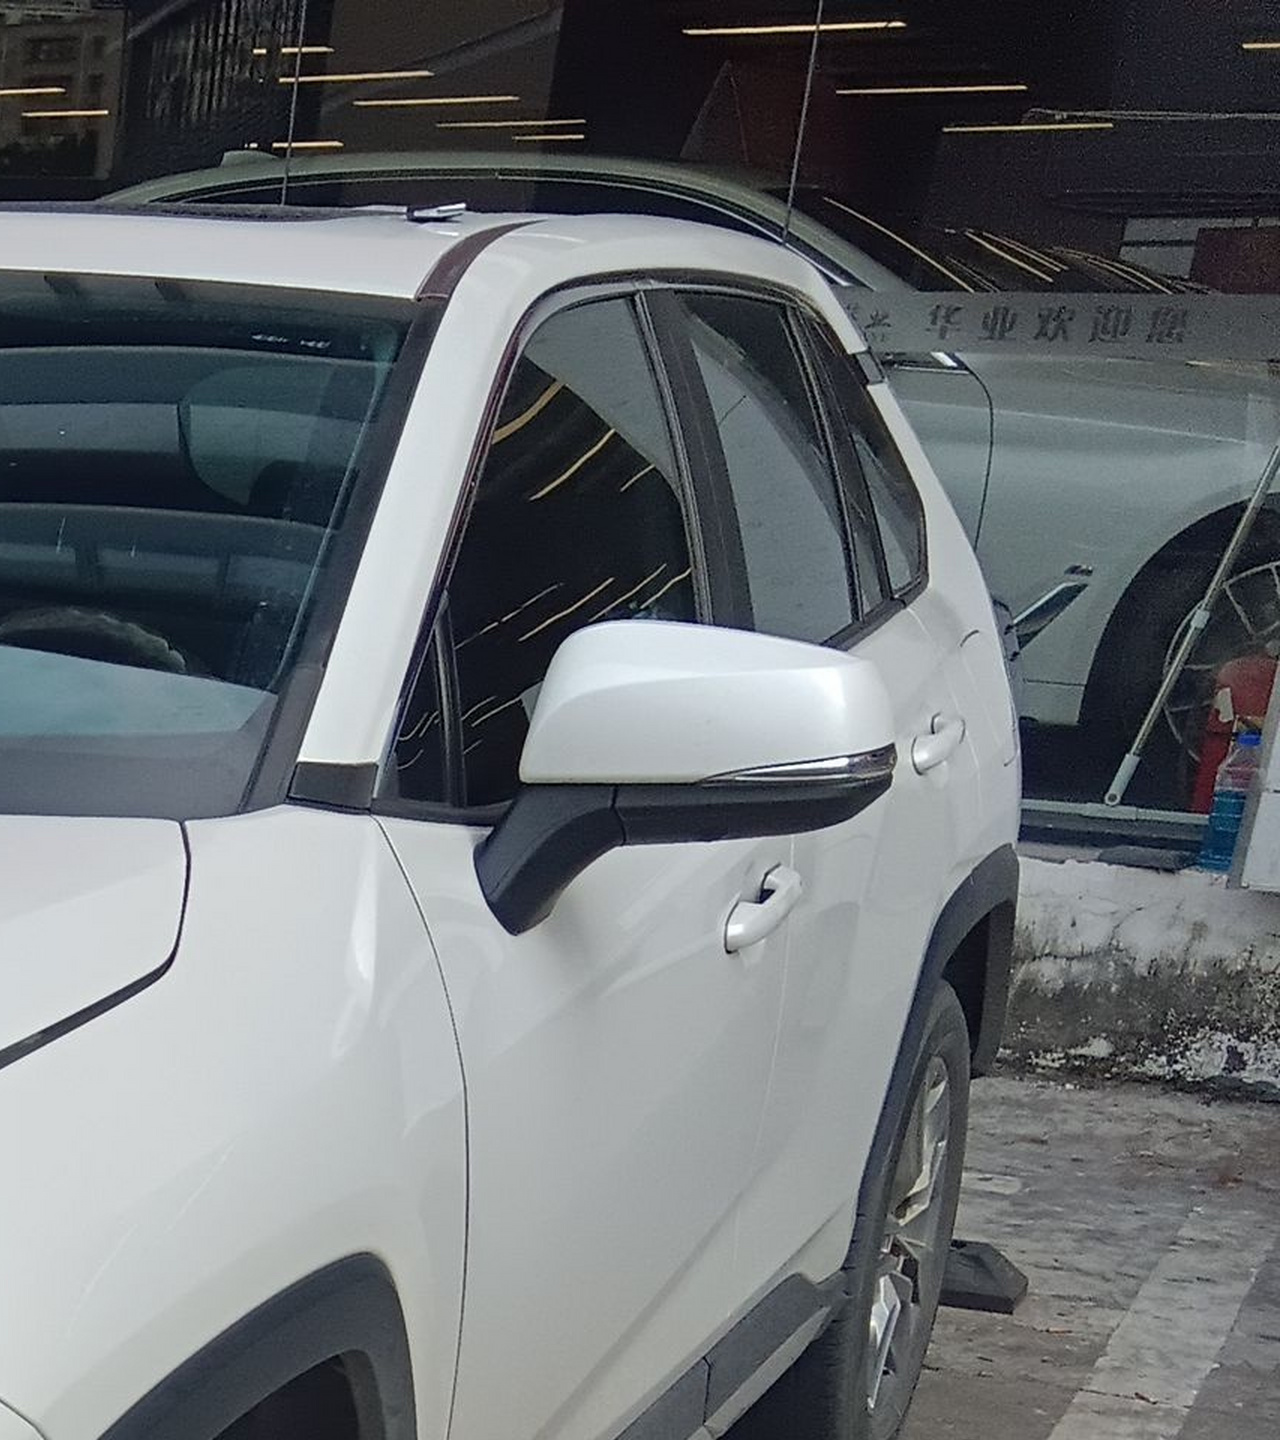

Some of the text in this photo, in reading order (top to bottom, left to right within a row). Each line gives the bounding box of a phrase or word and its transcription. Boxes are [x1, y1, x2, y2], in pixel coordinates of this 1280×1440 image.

[925, 304, 1188, 343] 华业欢迎您
